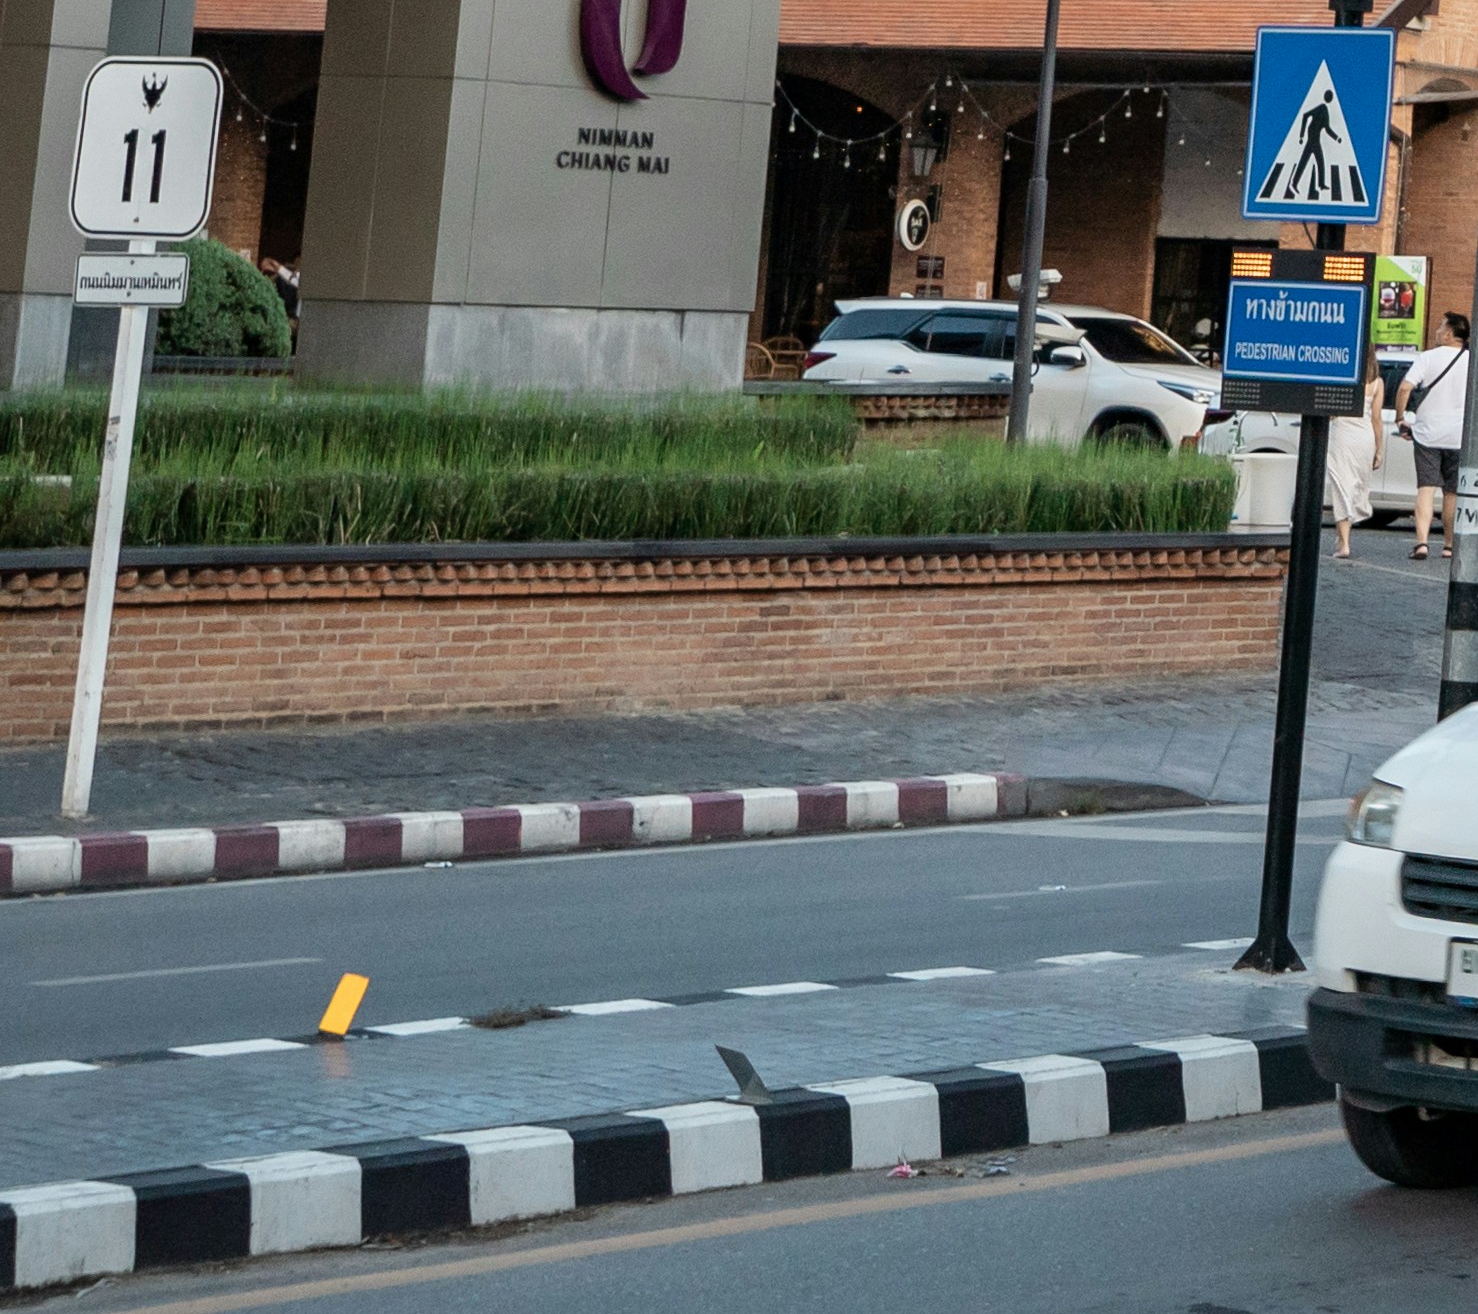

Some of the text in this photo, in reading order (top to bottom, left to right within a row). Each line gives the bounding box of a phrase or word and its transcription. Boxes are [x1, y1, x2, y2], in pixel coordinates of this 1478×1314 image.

[577, 127, 654, 149] NIMMAN
[121, 128, 166, 203] 11
[556, 150, 670, 175] CHIANG MAI
[1245, 289, 1346, 324] ทางข้ามถนน
[1234, 341, 1350, 364] PEDESTRIAN CROSSING
